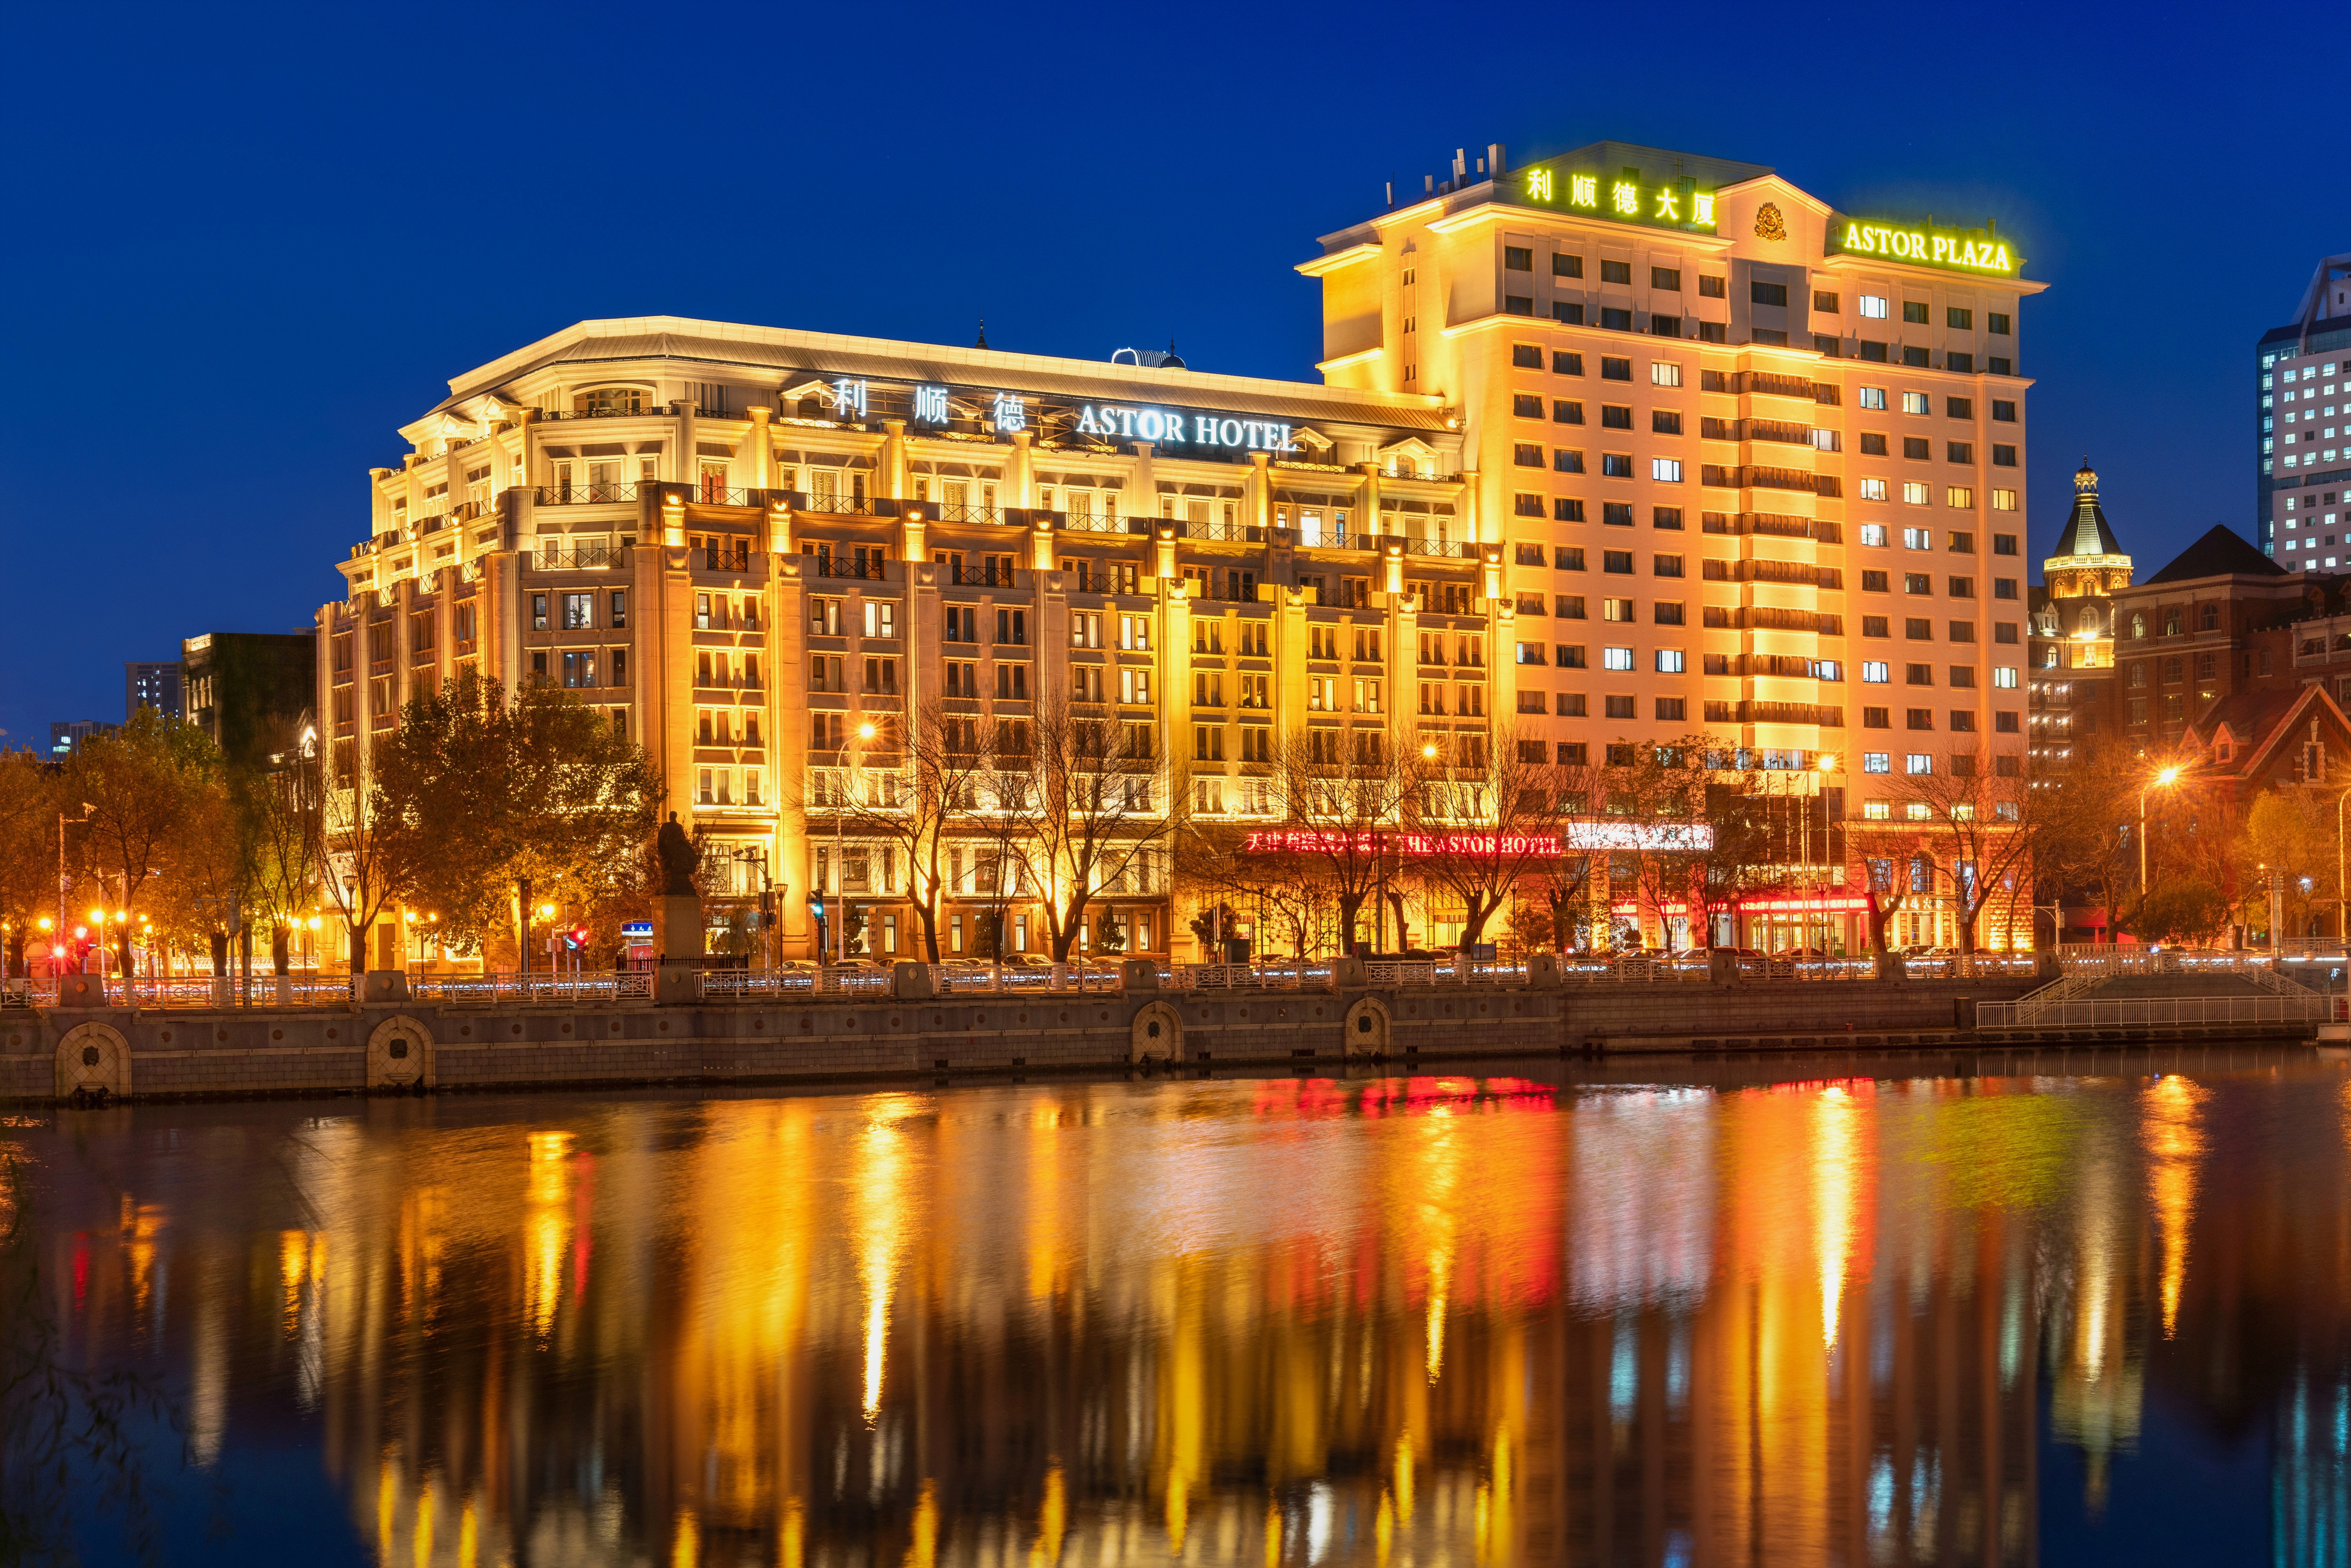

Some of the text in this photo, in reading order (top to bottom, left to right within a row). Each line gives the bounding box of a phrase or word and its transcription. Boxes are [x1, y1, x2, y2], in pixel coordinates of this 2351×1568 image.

[1528, 169, 1716, 225] 利顺德大厦
[1845, 224, 2010, 271] ASTOR PLAZA
[832, 379, 1297, 452] 利顺德 ASTOR HOTEL
[1436, 836, 1497, 854] ASTOR
[1500, 837, 1561, 854] HOTEL
